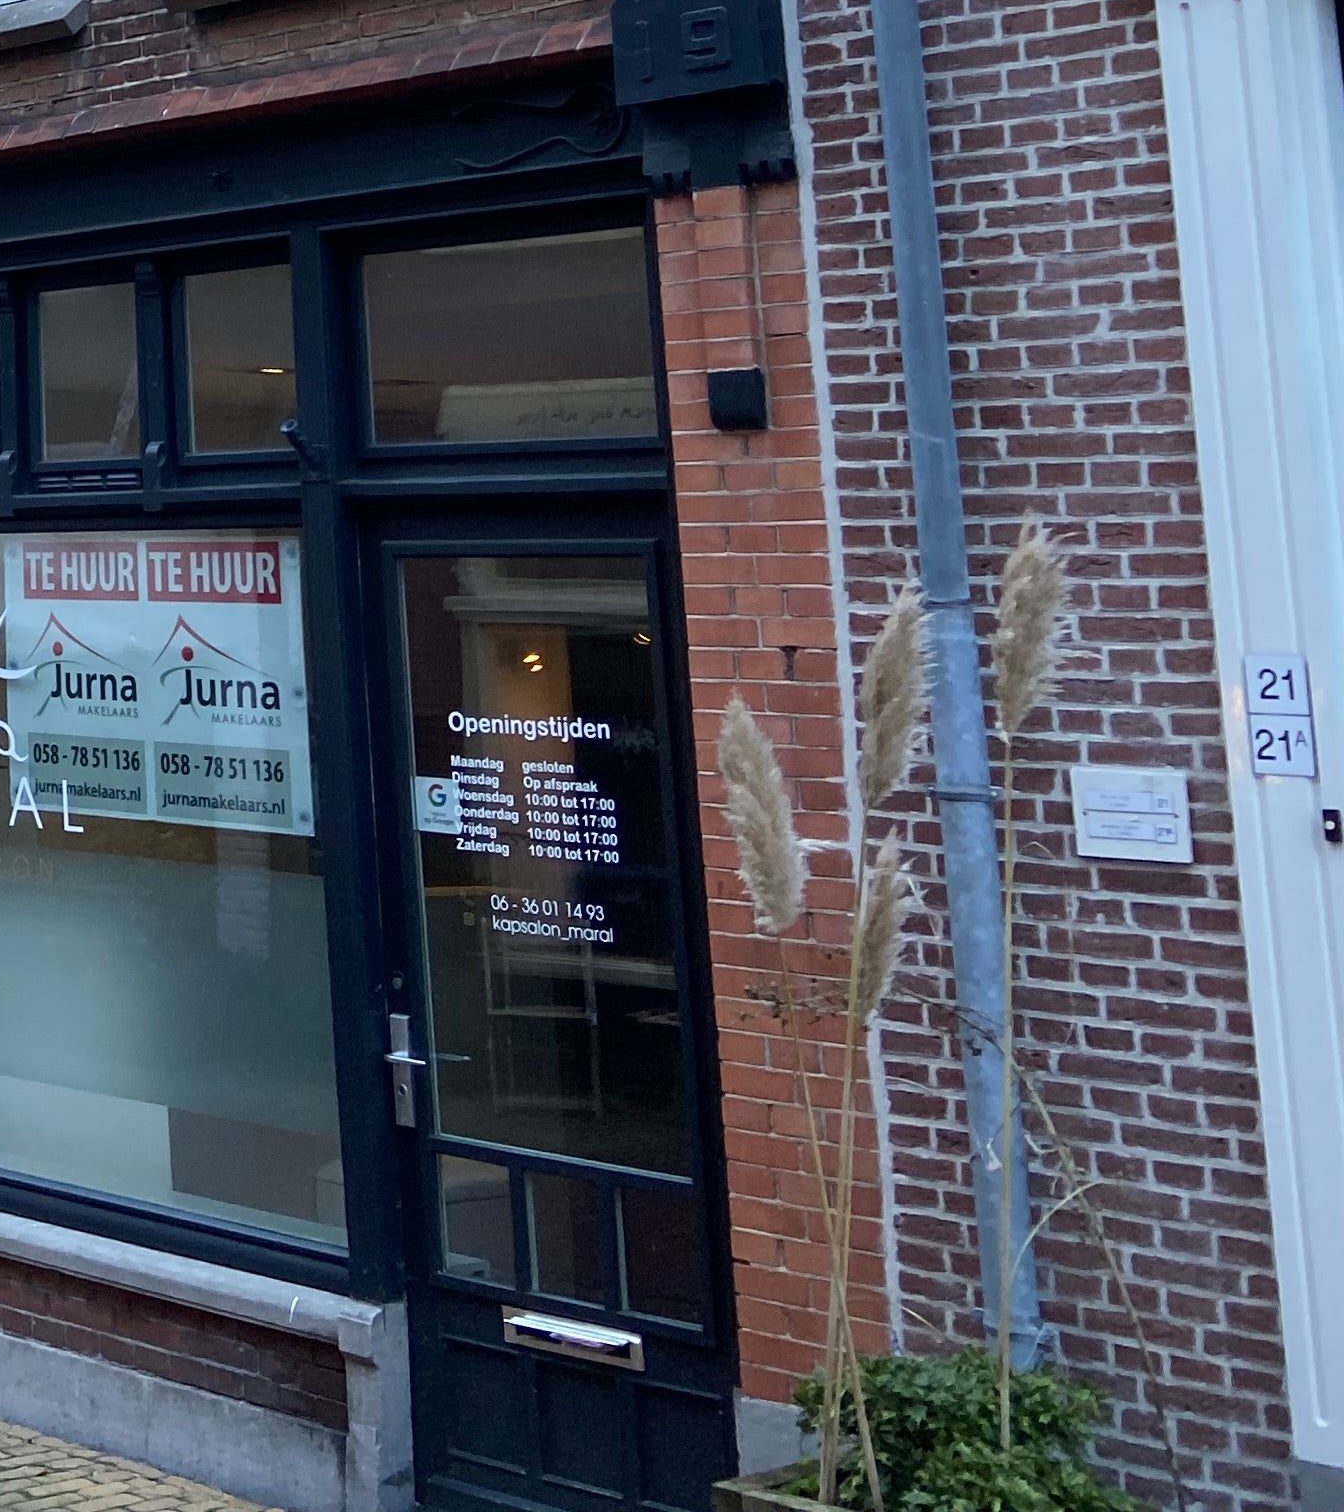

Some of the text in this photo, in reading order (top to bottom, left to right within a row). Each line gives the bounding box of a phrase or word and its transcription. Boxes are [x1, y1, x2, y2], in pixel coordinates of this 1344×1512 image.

[25, 551, 135, 592] TE HUUR
[149, 551, 277, 595] TE HUUR
[50, 662, 138, 703] Jurna
[180, 668, 281, 711] Jurna
[1258, 668, 1295, 701] 21
[78, 705, 139, 719] MAKELAARS
[211, 713, 282, 727] MAKELAARS
[448, 711, 610, 743] Openingstijden
[33, 743, 60, 765] 058
[71, 745, 89, 767] 78
[92, 747, 109, 769] 51
[114, 749, 140, 771] 136
[160, 753, 190, 776] 058
[204, 756, 224, 778] 78
[229, 758, 247, 780] 51
[253, 759, 284, 783] 136
[450, 755, 574, 774] Maandag gesloten
[34, 777, 142, 802] jurnamakelaars.nl
[452, 771, 598, 793] Dinsdag Op afspraak
[162, 789, 286, 815] jurnamakelaars.nl
[454, 788, 615, 811] Woensdag 10:00 tot 17:00
[454, 804, 519, 824] Donderdag
[526, 810, 559, 824] 10:00
[562, 813, 580, 826] tot
[582, 814, 616, 828] 17:00
[455, 821, 618, 846] Vrijdag 10:00 tot 17:00
[456, 837, 510, 857] Zaterdag
[565, 847, 582, 861] tot
[490, 894, 509, 911] 06
[521, 897, 539, 915] 36
[542, 899, 559, 916] 01
[565, 901, 582, 919] 14
[585, 904, 605, 922] 93
[492, 914, 614, 943] kapsalon_maral
